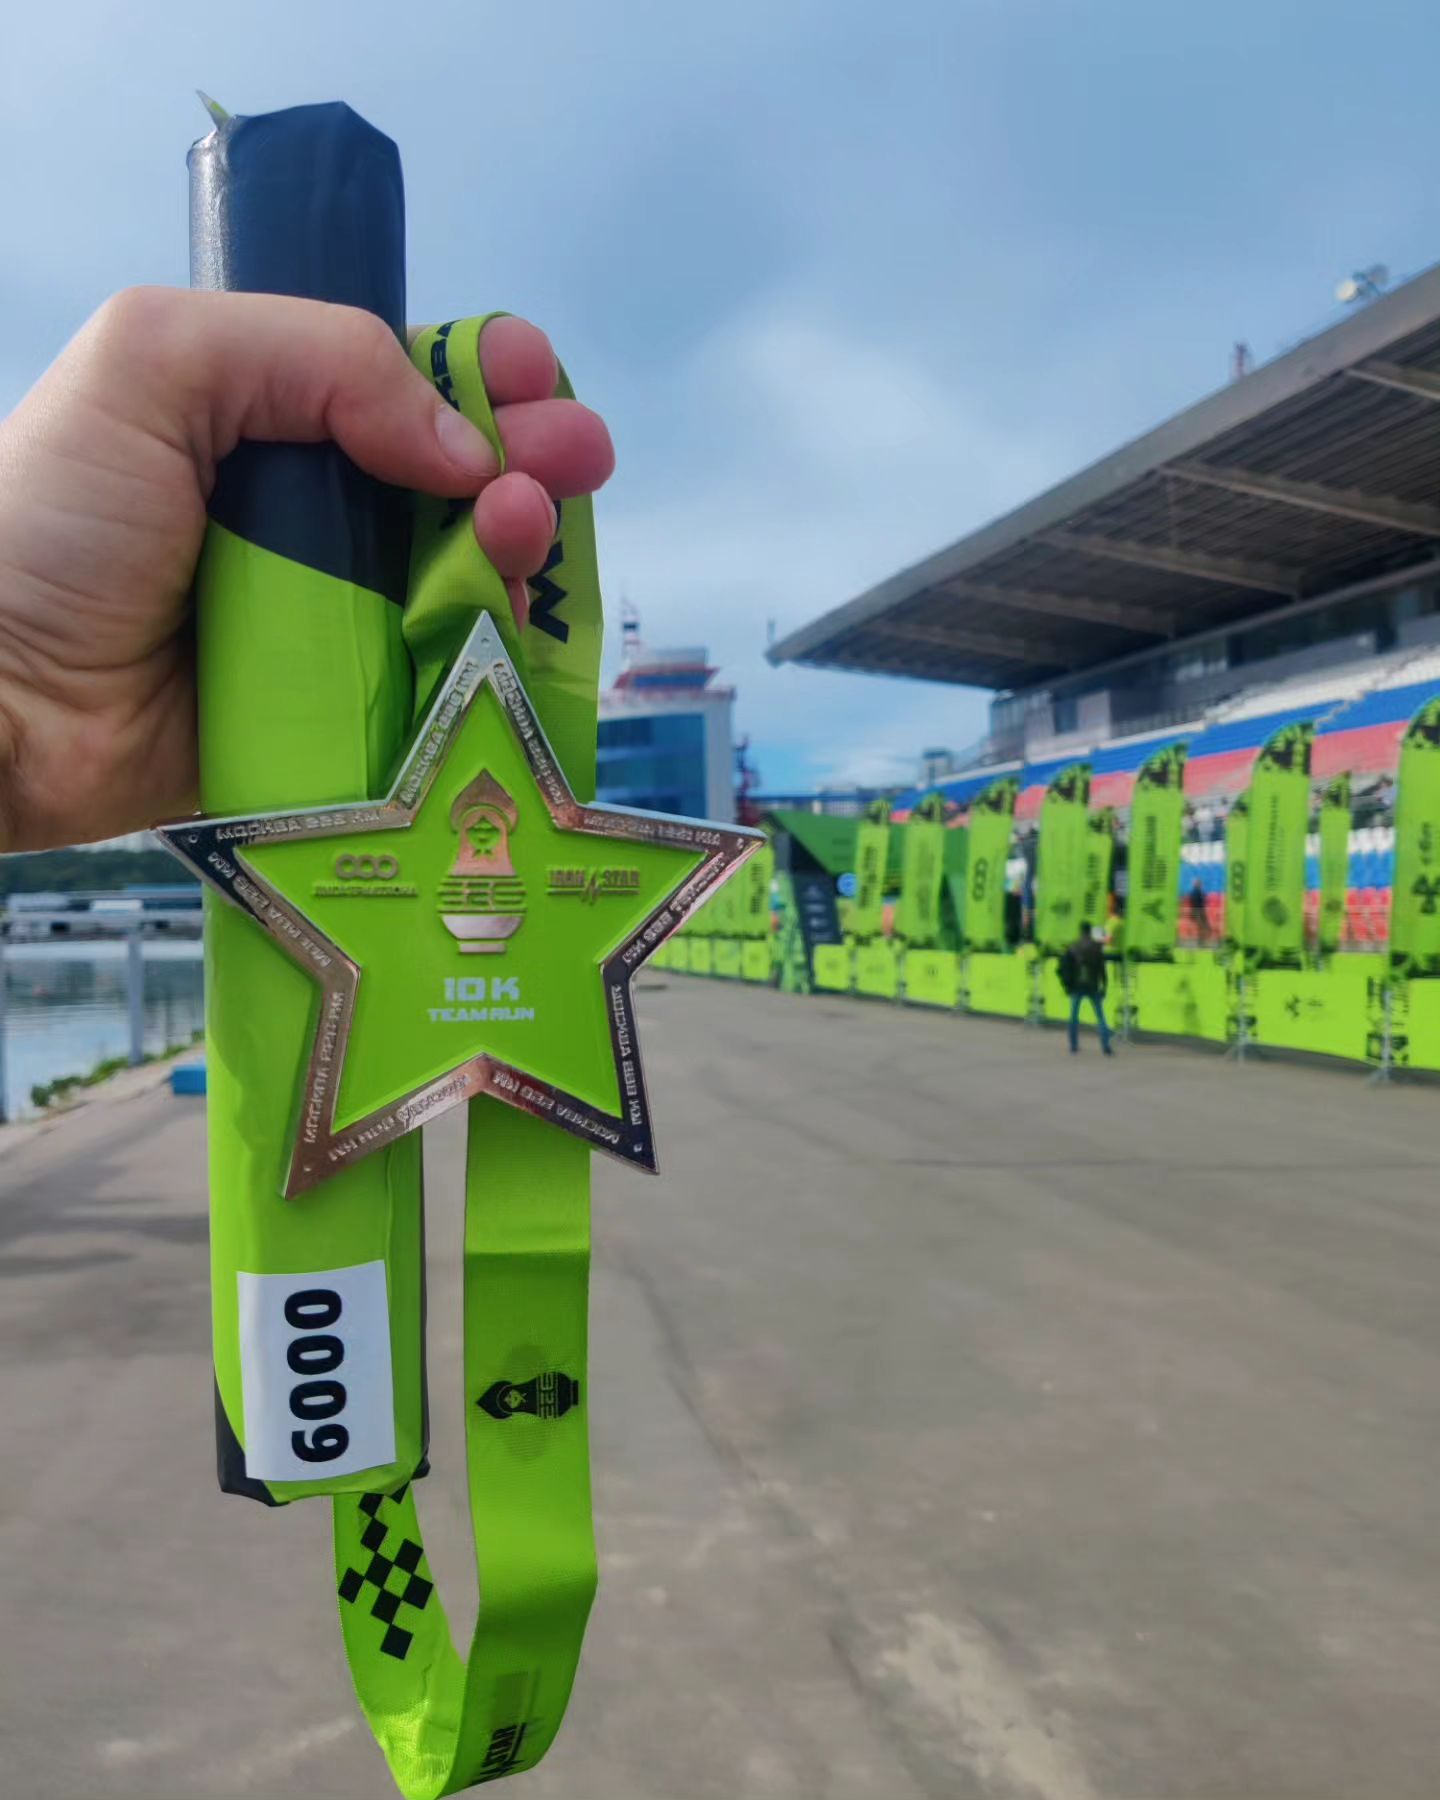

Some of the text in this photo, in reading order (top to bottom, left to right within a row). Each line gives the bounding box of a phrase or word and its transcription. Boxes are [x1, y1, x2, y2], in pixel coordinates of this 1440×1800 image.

[445, 976, 486, 1002] 10
[427, 1007, 535, 1023] TEAM RUN
[284, 1289, 349, 1463] 6000
